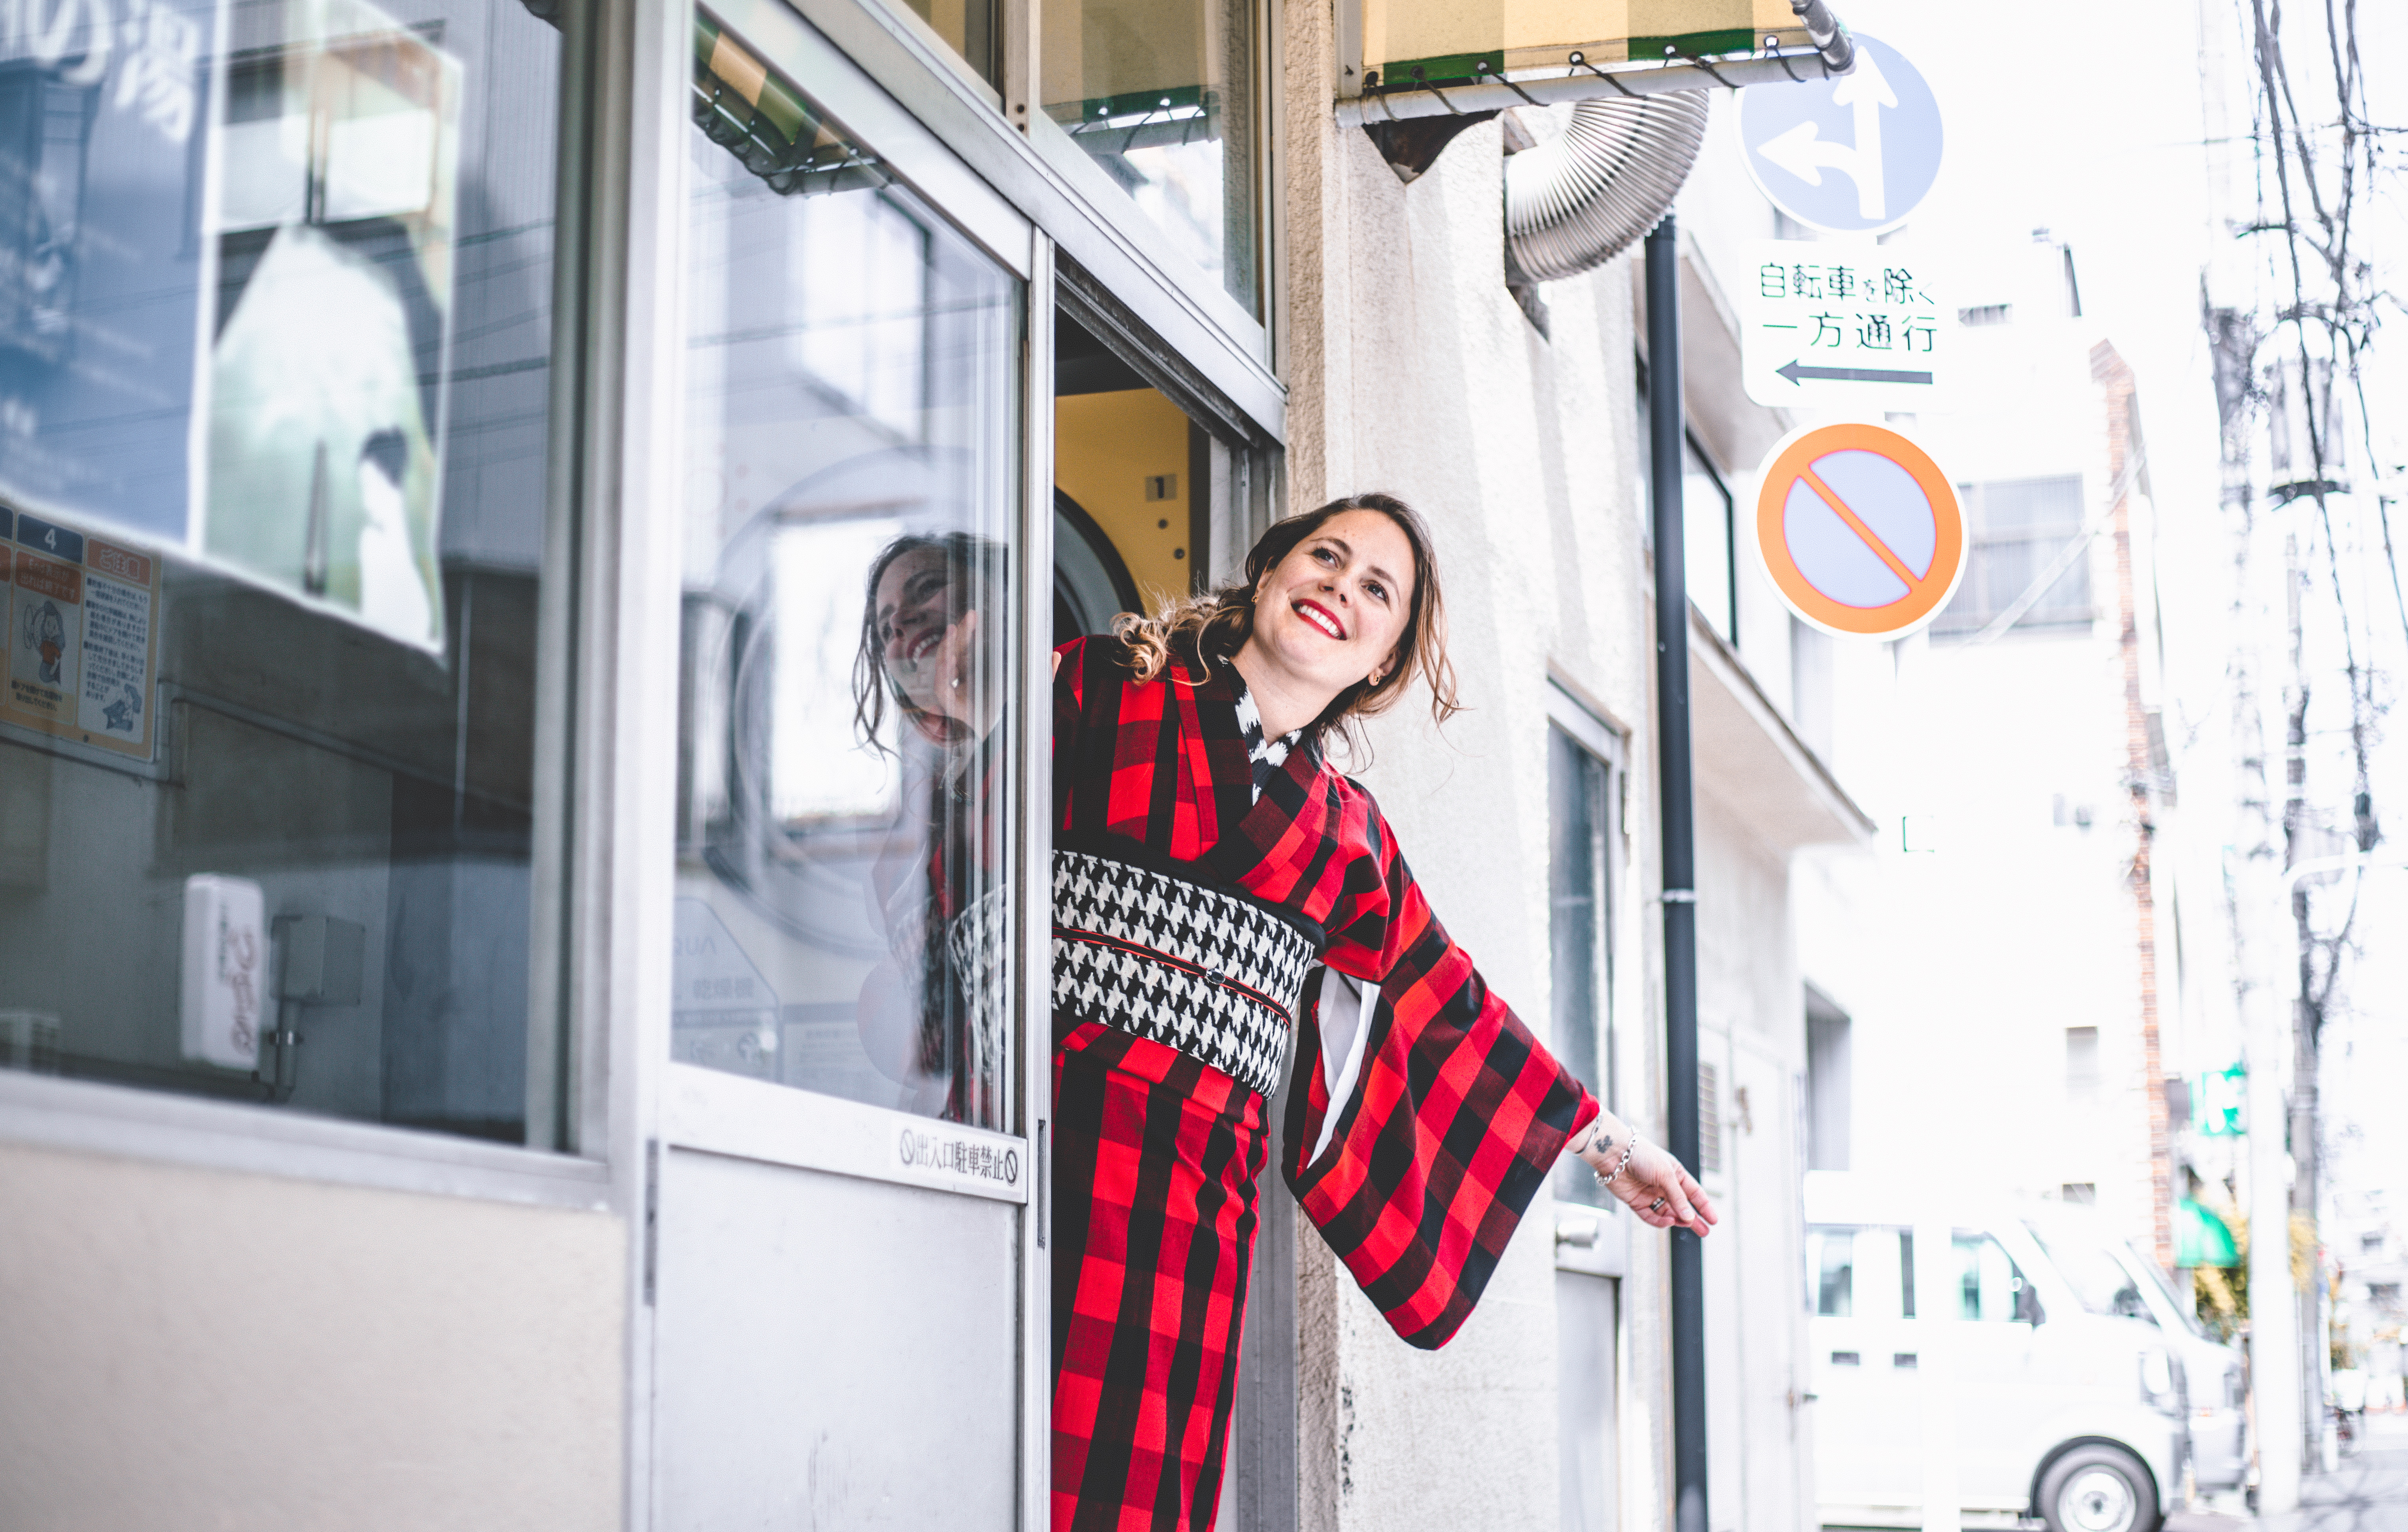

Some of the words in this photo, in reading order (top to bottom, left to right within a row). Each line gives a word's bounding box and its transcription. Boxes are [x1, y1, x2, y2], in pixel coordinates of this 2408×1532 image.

[1761, 262, 1935, 304] 自転車を除く
[1762, 311, 1937, 352] 一方通行
[1154, 476, 1165, 499] 1
[44, 527, 57, 551] 4
[916, 1133, 1003, 1181] 出入口駐車禁止
